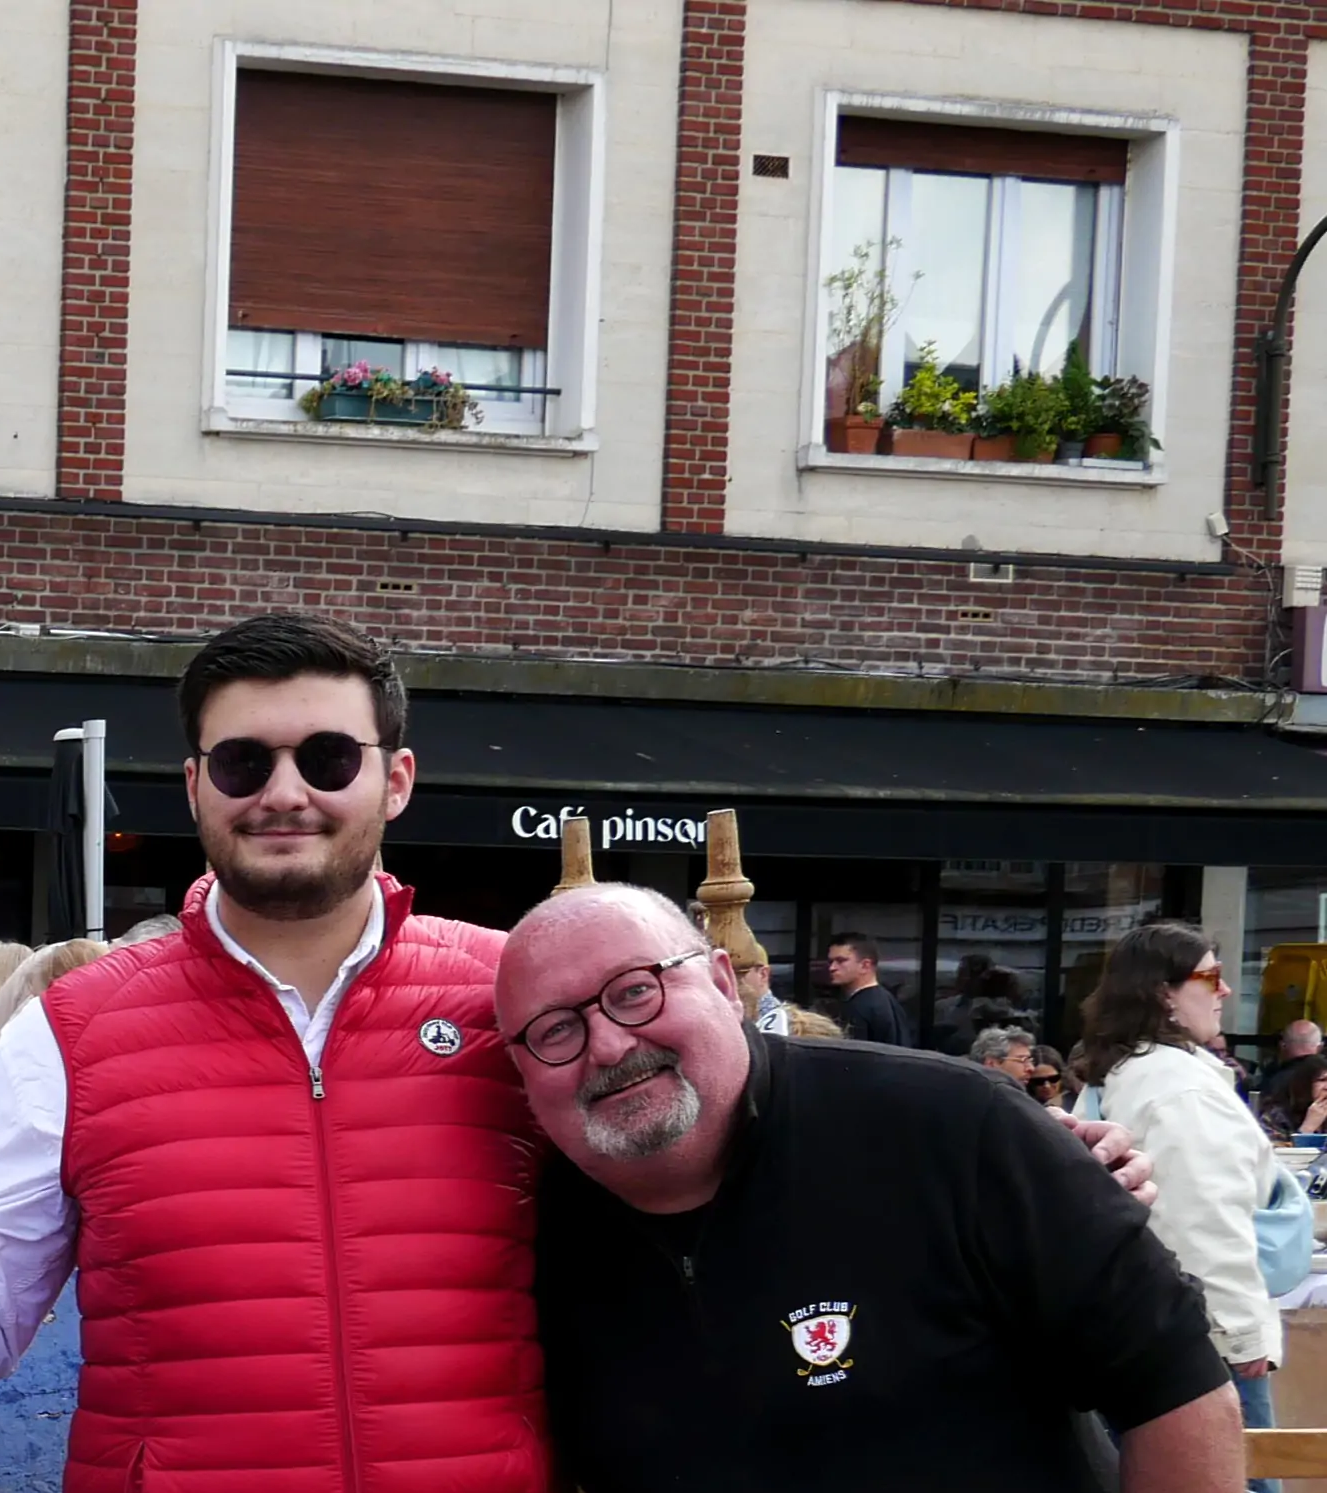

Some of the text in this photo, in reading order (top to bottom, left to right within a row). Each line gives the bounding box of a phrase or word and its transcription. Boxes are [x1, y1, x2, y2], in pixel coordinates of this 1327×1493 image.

[788, 1302, 848, 1322] GOLF CLUB
[807, 1369, 847, 1387] AMIENS
